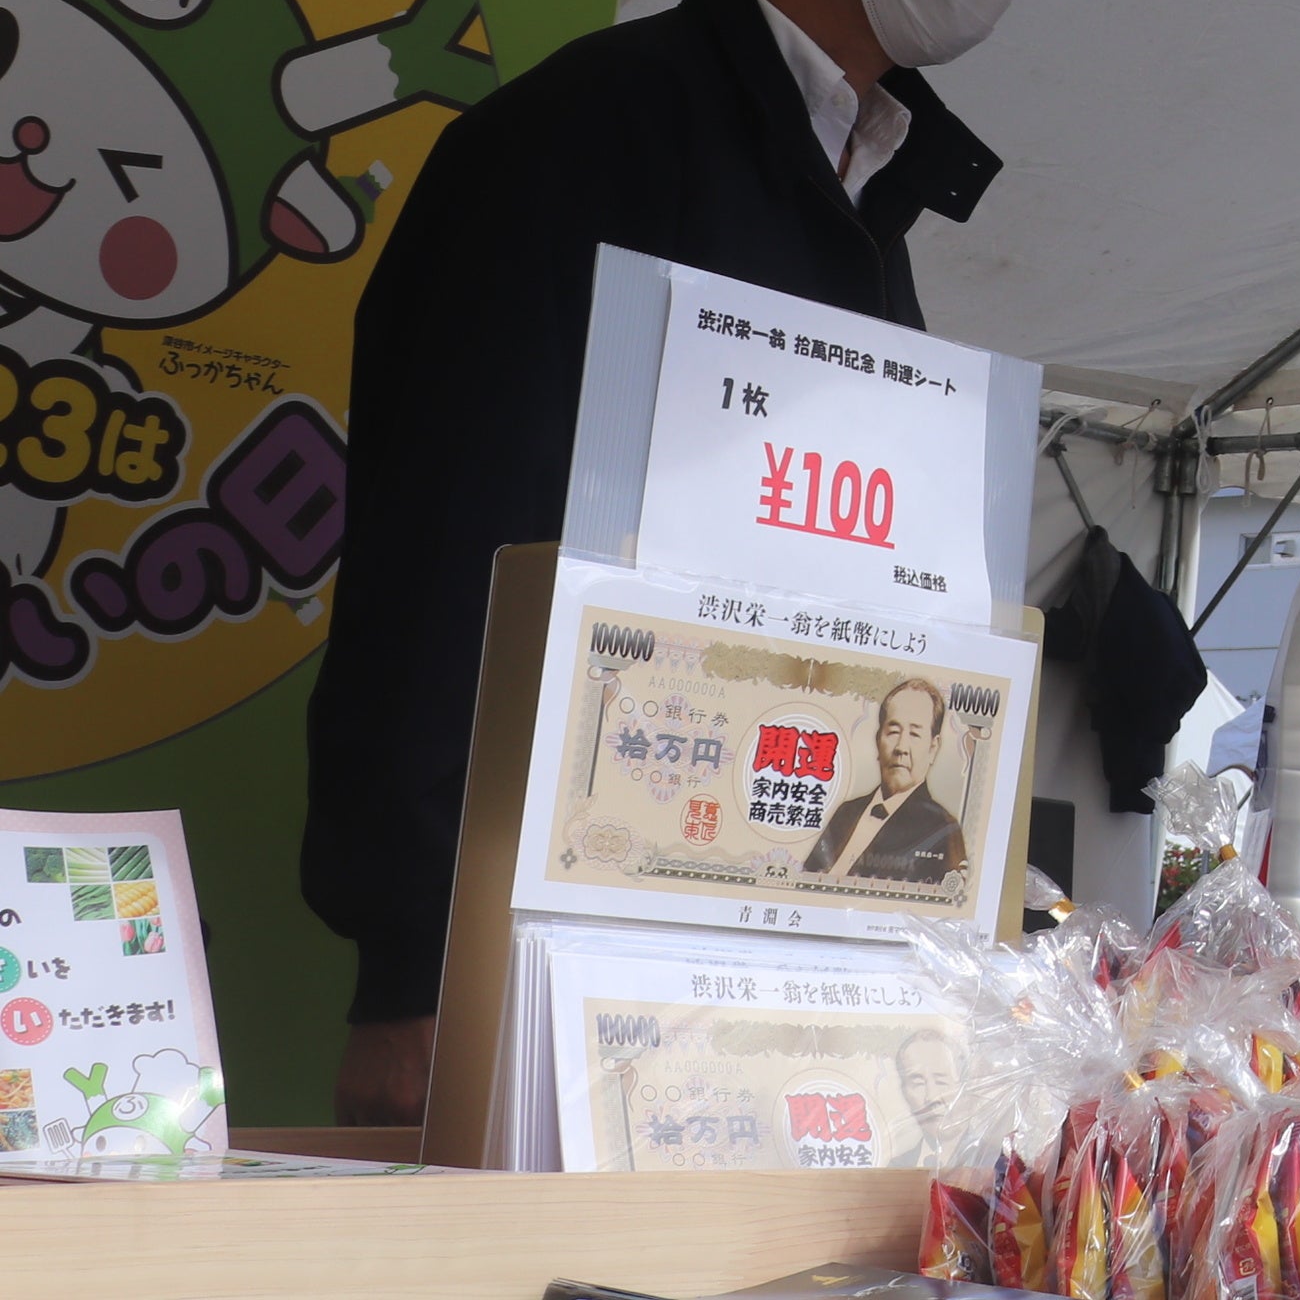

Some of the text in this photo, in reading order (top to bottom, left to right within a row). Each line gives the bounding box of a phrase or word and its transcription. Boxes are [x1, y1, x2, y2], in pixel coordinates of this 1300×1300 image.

[159, 350, 285, 395] ふっかちゃん
[883, 358, 957, 397] 開運シート
[721, 376, 770, 418] 1枚
[0, 375, 170, 485] 3は
[756, 440, 896, 549] ¥100
[892, 565, 948, 593] 税込価格
[590, 621, 656, 662] 100000
[698, 593, 928, 656] 渋沢栄一翁を紙幣にしよう
[948, 682, 1001, 718] 100000
[616, 726, 724, 770] 拾万円
[752, 724, 840, 783] 開運
[752, 778, 828, 807] 家内安全
[748, 800, 823, 832] 商売繁盛
[690, 973, 924, 1009] 渋沢栄一翁を紙幣にしよう
[648, 1113, 761, 1146] 拾万円
